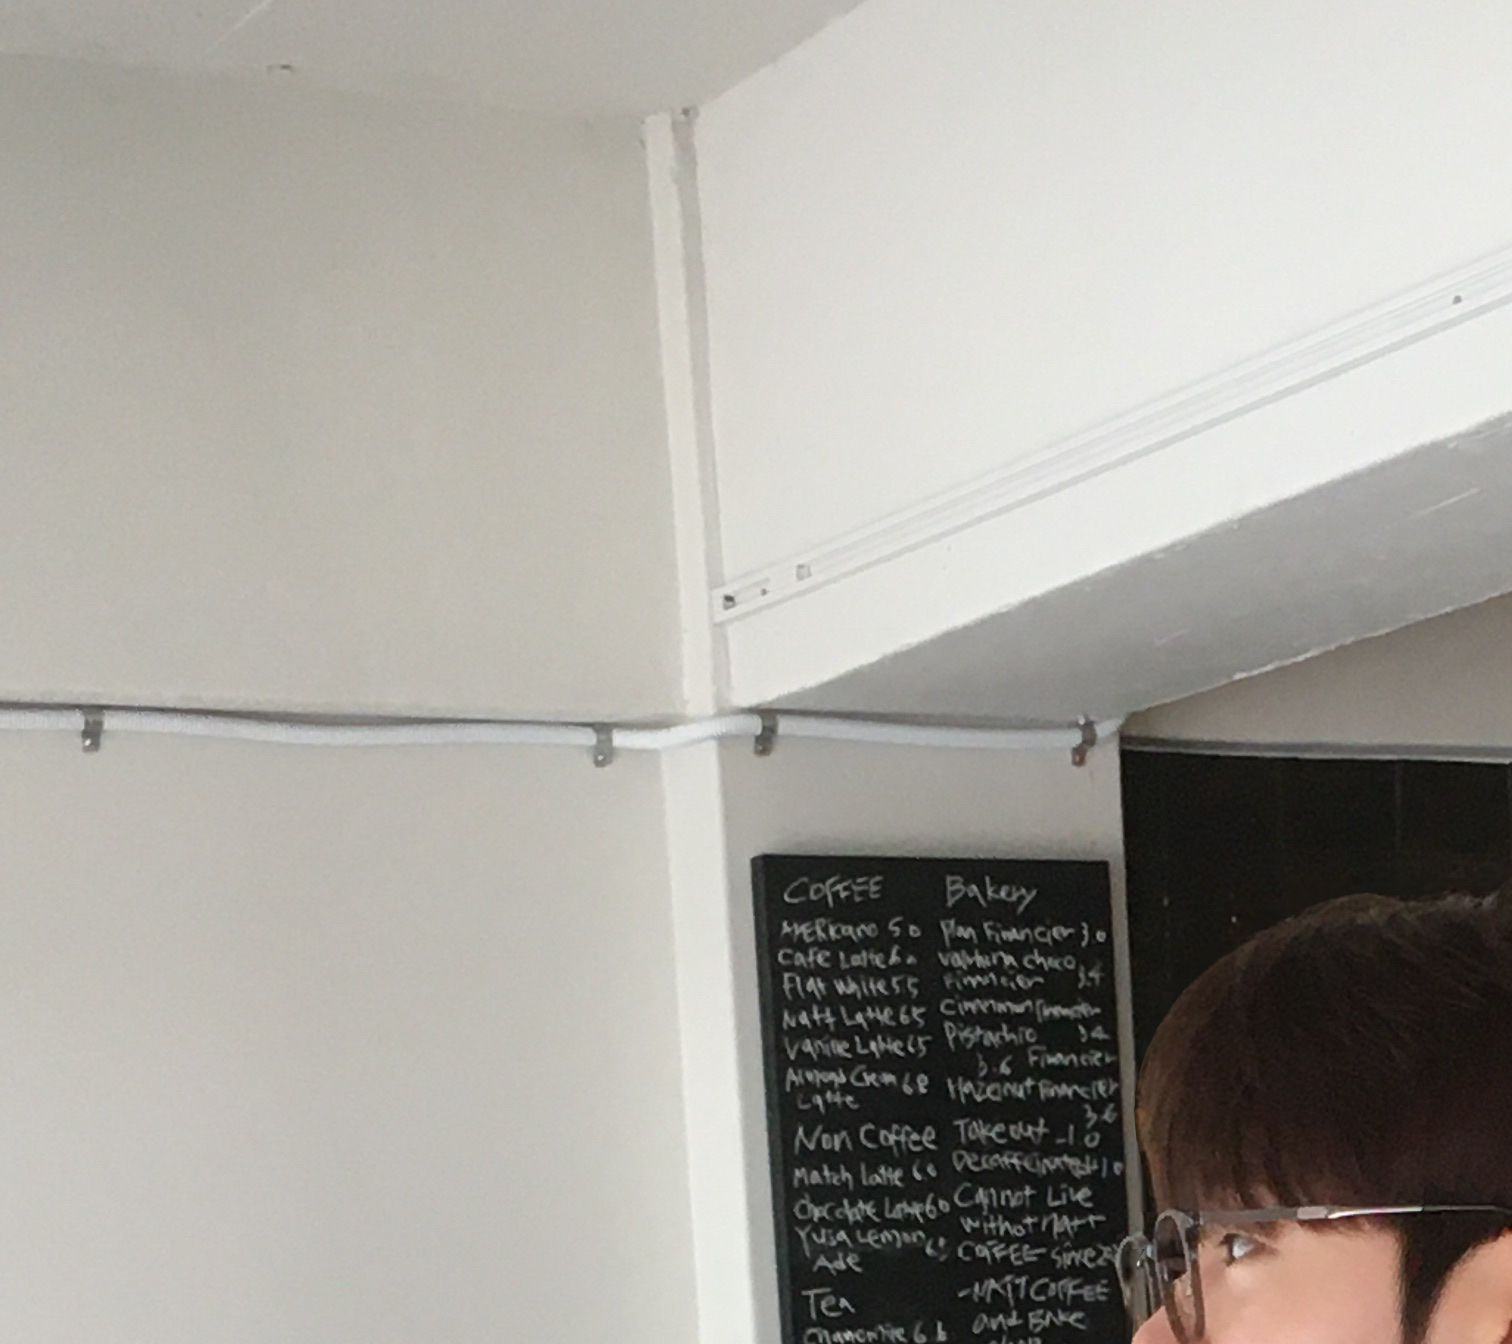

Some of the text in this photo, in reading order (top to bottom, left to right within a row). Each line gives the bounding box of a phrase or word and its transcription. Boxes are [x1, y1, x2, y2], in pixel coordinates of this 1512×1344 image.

[945, 874, 1038, 916] Bakery
[794, 1122, 938, 1158] Non Coffee
[801, 1287, 856, 1321] Tea
